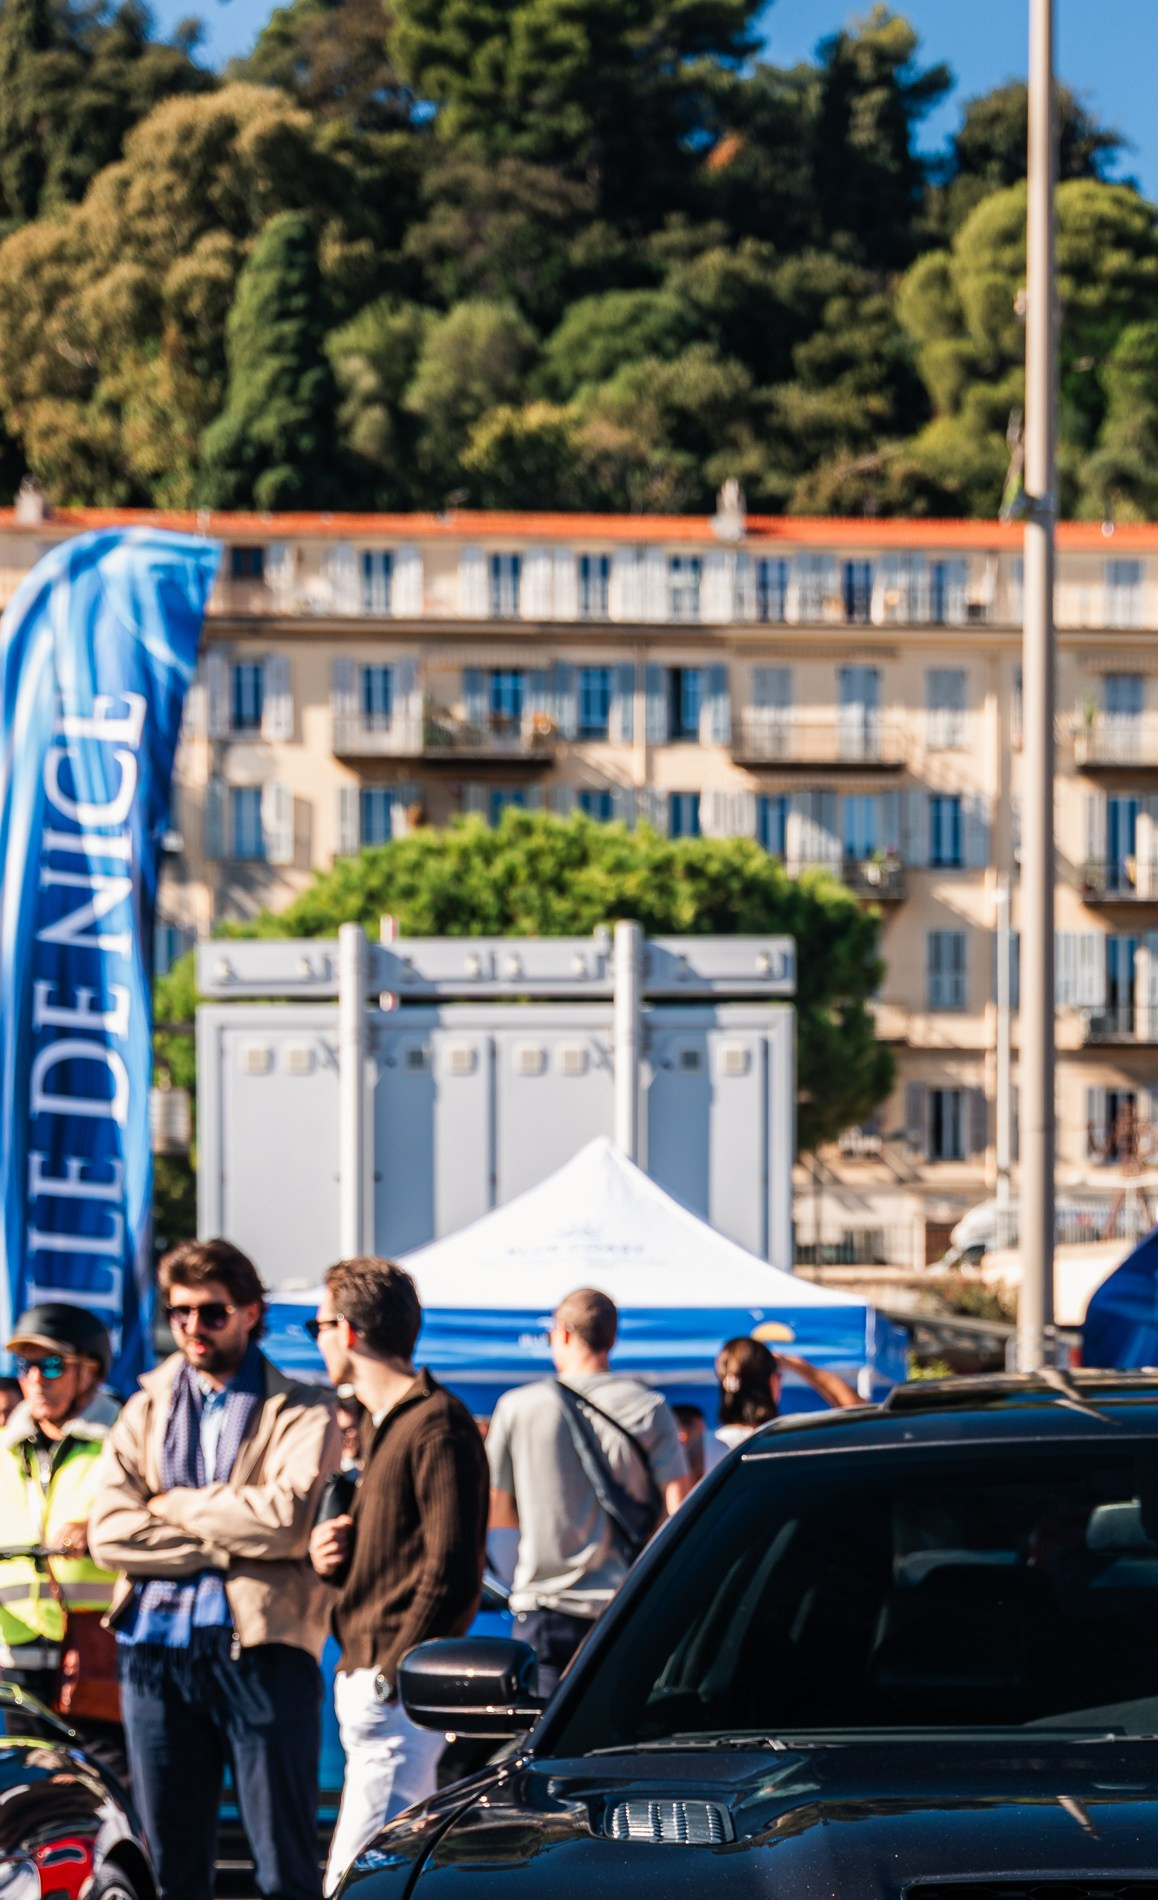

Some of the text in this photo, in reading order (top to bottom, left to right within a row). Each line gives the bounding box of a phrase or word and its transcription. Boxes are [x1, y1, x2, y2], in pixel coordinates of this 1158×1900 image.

[27, 690, 148, 1356] LLE DE NICE
